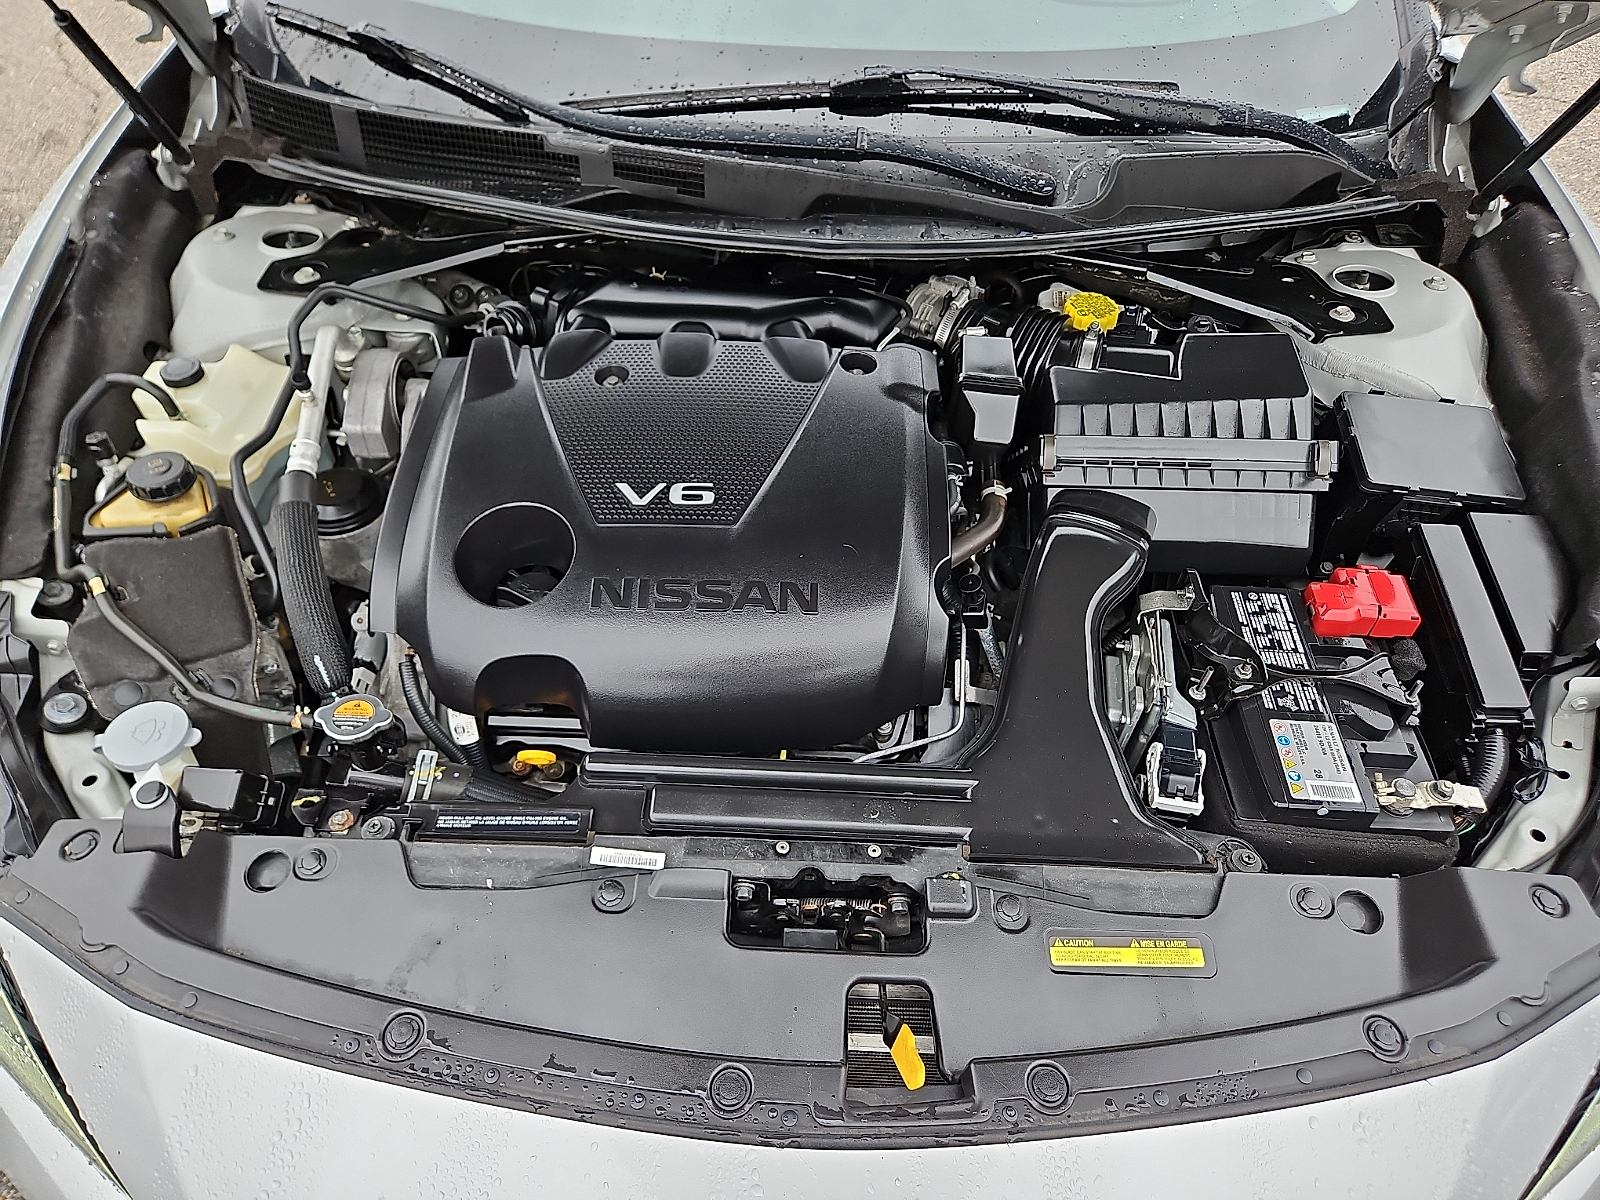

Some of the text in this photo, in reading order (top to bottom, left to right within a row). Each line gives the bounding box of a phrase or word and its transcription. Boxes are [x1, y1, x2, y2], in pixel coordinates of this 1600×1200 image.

[615, 482, 715, 506] V6
[589, 577, 819, 616] NISSAN
[1313, 769, 1323, 778] 28
[1063, 939, 1095, 947] CAUTION
[1139, 939, 1188, 948] MISE EN GARDE
